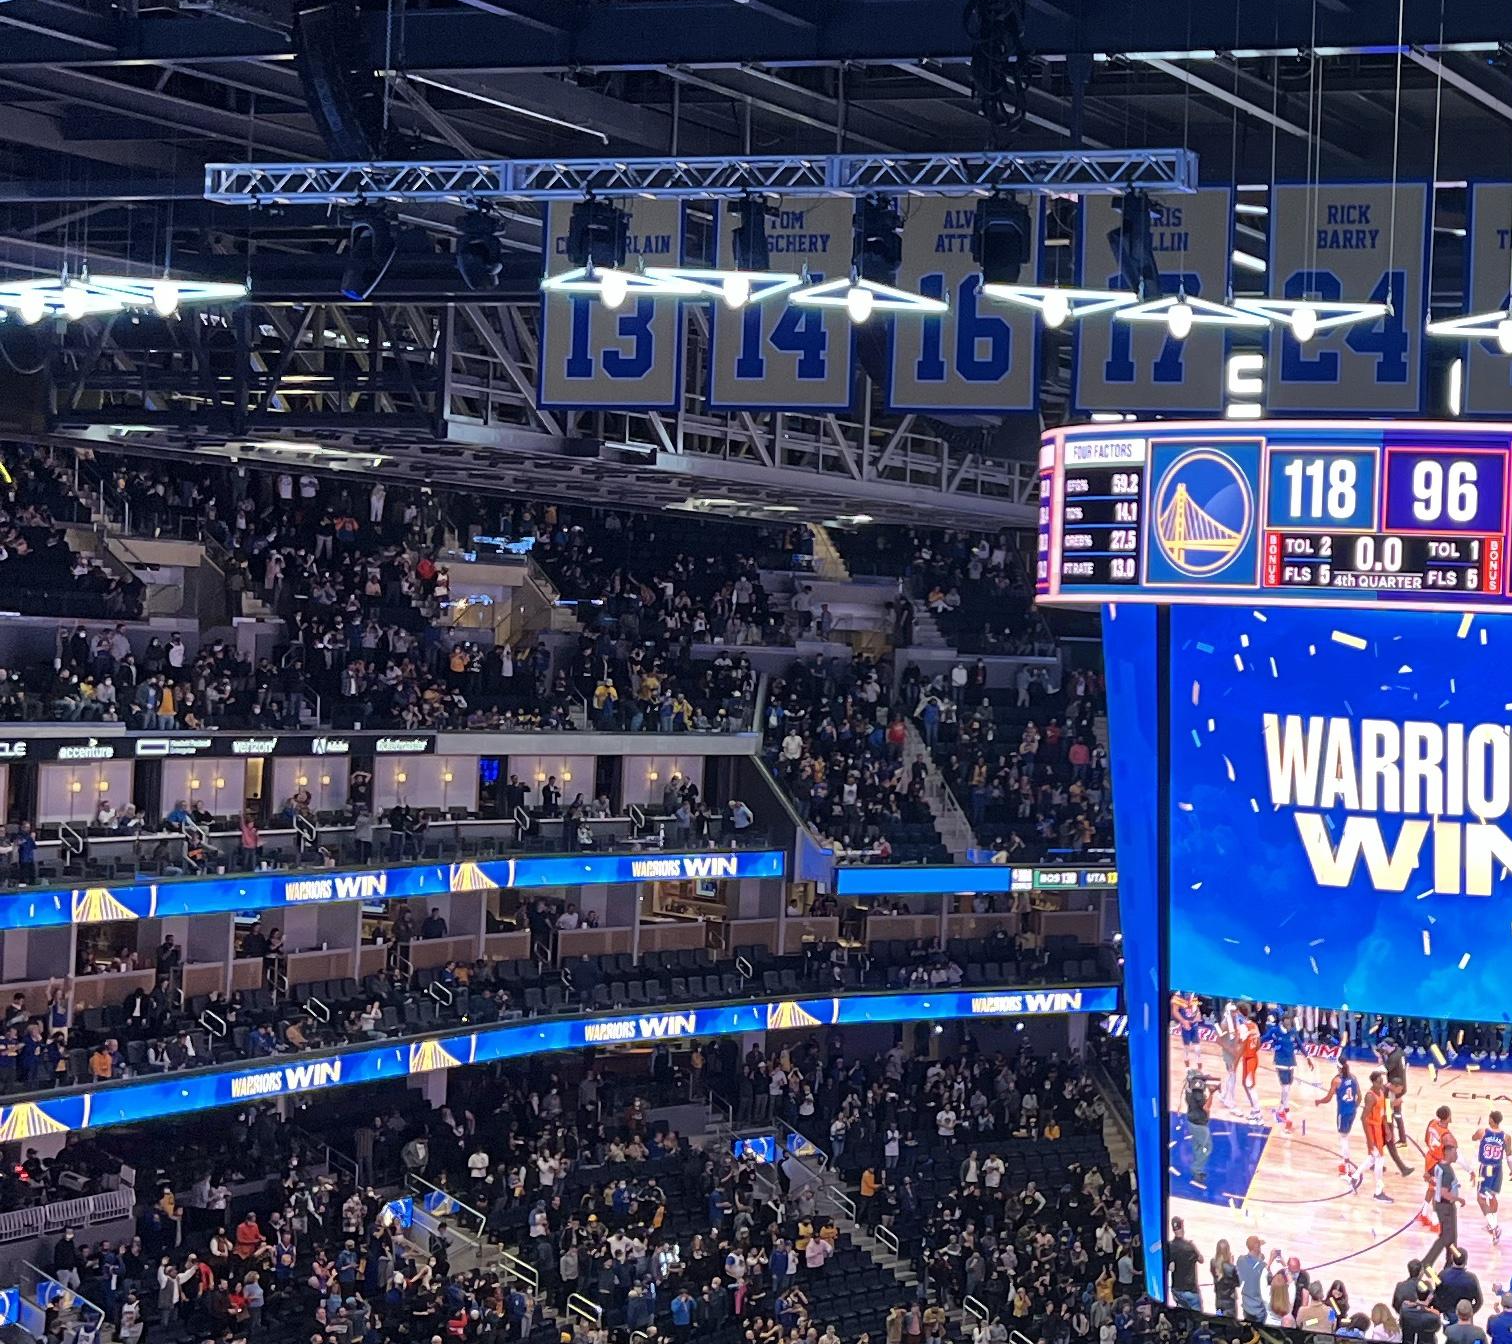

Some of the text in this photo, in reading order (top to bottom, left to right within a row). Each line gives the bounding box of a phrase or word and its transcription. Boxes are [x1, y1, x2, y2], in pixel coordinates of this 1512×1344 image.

[943, 210, 976, 229] ALV
[1326, 204, 1372, 225] RICK
[555, 233, 672, 255] CRLAIN
[767, 233, 831, 253] SCHERY
[1316, 228, 1380, 250] BARRY
[564, 293, 656, 379] 13
[734, 272, 828, 380] 14
[915, 272, 1012, 384] 16
[1104, 273, 1205, 384] 17
[1280, 269, 1409, 385] 24
[1094, 443, 1133, 458] FACTORS
[1111, 473, 1139, 495] 59.2
[1284, 458, 1357, 520] 118
[1411, 460, 1479, 523] 96
[1115, 502, 1138, 523] 14.1
[1110, 529, 1137, 552] 27.5
[1284, 535, 1332, 557] TOL 2
[1427, 540, 1479, 561] TOL 1
[1267, 534, 1278, 585] BONUS
[1355, 535, 1403, 572] 0.0
[1074, 562, 1095, 576] RATE
[1110, 558, 1136, 581] 13.0
[1284, 564, 1331, 585] FLS 5
[1489, 539, 1499, 591] BONUS
[1333, 573, 1422, 590] 4th QUARTER
[1427, 568, 1478, 589] FLS 5
[58, 745, 115, 761] accenture
[232, 738, 275, 754] verizon
[632, 856, 738, 877] WARRIORS WIN
[285, 874, 387, 901] WARRIORS WIN
[971, 992, 1083, 1013] WARRIORS WIN
[584, 1014, 697, 1042] WARRIORS WIN
[231, 1060, 342, 1098] WARRIORS WIN
